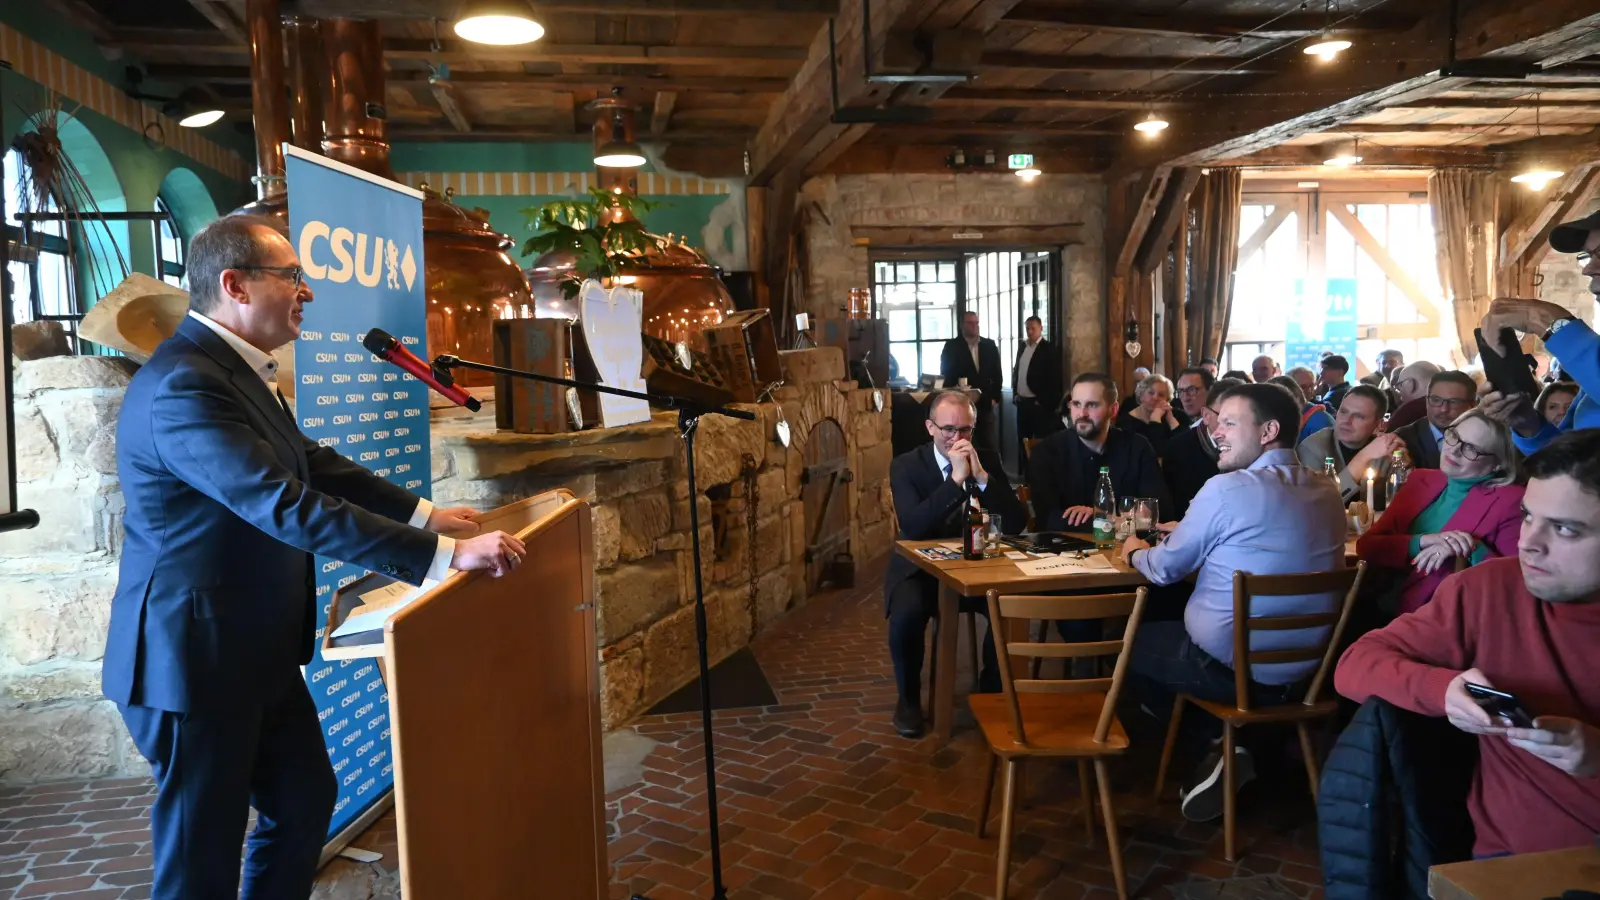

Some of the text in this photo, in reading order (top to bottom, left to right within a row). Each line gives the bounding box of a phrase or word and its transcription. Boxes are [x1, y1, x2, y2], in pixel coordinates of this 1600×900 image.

[299, 220, 384, 288] CSU
[301, 330, 314, 340] CSU
[330, 332, 344, 342] CSU
[402, 336, 413, 344] CSU
[316, 353, 330, 362] CSU
[344, 354, 358, 362] CSU
[302, 375, 314, 384] CSU
[332, 374, 344, 383] CSU
[358, 374, 370, 382] CSU
[384, 373, 394, 382] CSU
[317, 396, 331, 405] CSU
[346, 394, 358, 403] CSU
[372, 392, 384, 401] CSU
[394, 392, 404, 400] CSU
[359, 413, 372, 422] CSU
[384, 411, 394, 420] CSU
[404, 409, 414, 417] CSU
[304, 418, 317, 428] CSU
[333, 416, 346, 425] CSU
[373, 432, 384, 440] CSU
[394, 428, 405, 436] CSU
[346, 434, 359, 444] CSU
[386, 448, 396, 457] CSU
[405, 444, 416, 454] CSU
[360, 452, 373, 461] CSU
[396, 464, 406, 474] CSU
[406, 480, 416, 489] CSU
[322, 560, 337, 572] CSU
[338, 576, 352, 588] CSU
[312, 668, 326, 682] CSU
[354, 667, 366, 680] CSU
[327, 682, 340, 696] CSU
[367, 680, 380, 692] CSU
[342, 694, 354, 708] CSU
[355, 706, 368, 718] CSU
[368, 717, 380, 730] CSU
[328, 722, 342, 736] CSU
[342, 733, 356, 746] CSU
[356, 744, 368, 757] CSU
[369, 754, 380, 767] CSU
[344, 772, 357, 786] CSU
[356, 782, 369, 796] CSU
